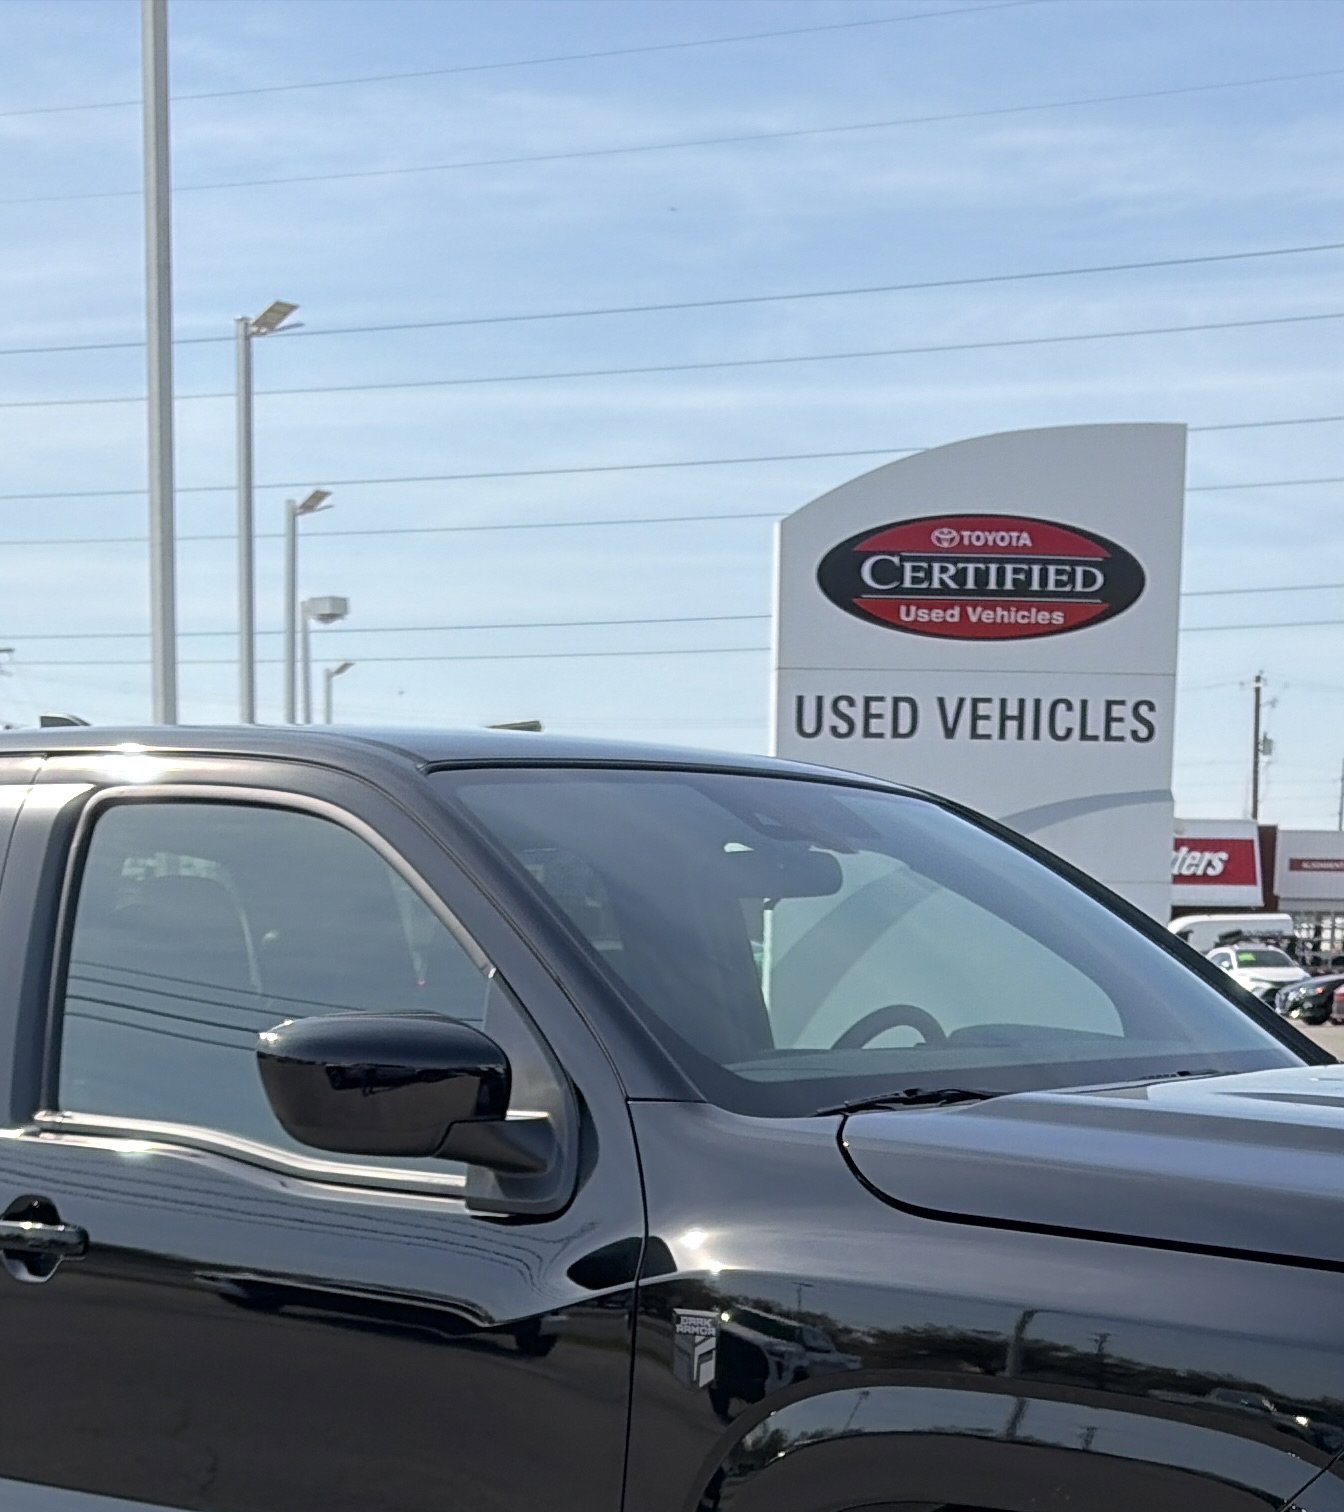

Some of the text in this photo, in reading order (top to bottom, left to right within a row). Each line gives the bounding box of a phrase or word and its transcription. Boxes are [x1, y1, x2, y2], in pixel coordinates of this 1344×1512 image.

[960, 530, 1033, 549] TOYOTA
[860, 553, 1104, 594] CERTIFIED
[899, 605, 1065, 626] Used Vehicles
[794, 694, 1158, 744] USED VEHICLES
